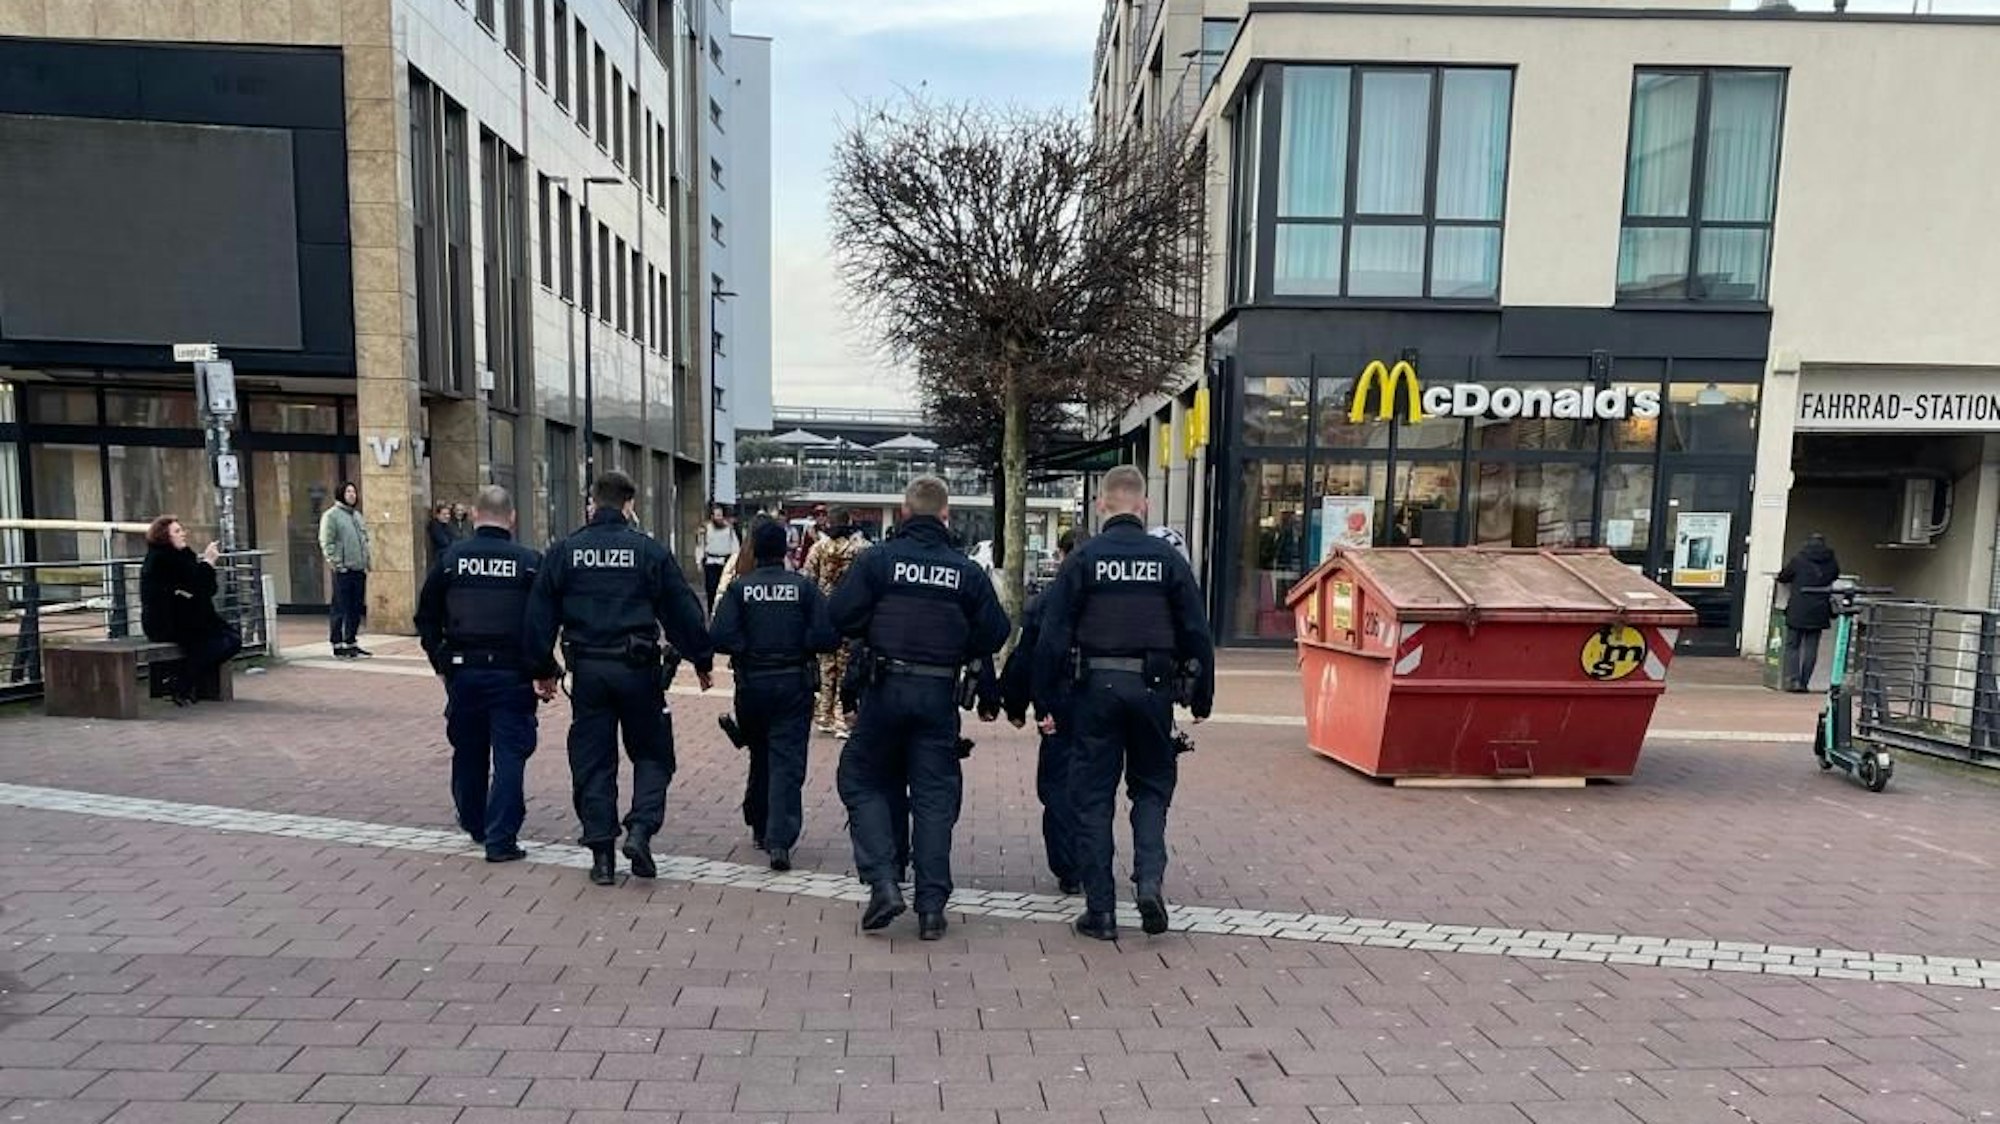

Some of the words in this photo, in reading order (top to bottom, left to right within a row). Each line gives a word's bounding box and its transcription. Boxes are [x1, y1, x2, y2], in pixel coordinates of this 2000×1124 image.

[1350, 360, 1660, 424] McDonald's
[458, 558, 517, 577] POLIZEI
[573, 549, 635, 568] POLIZEI
[893, 562, 961, 589] POLIZEI
[1096, 560, 1162, 581] POLIZEI
[743, 585, 800, 602] POLIZEI
